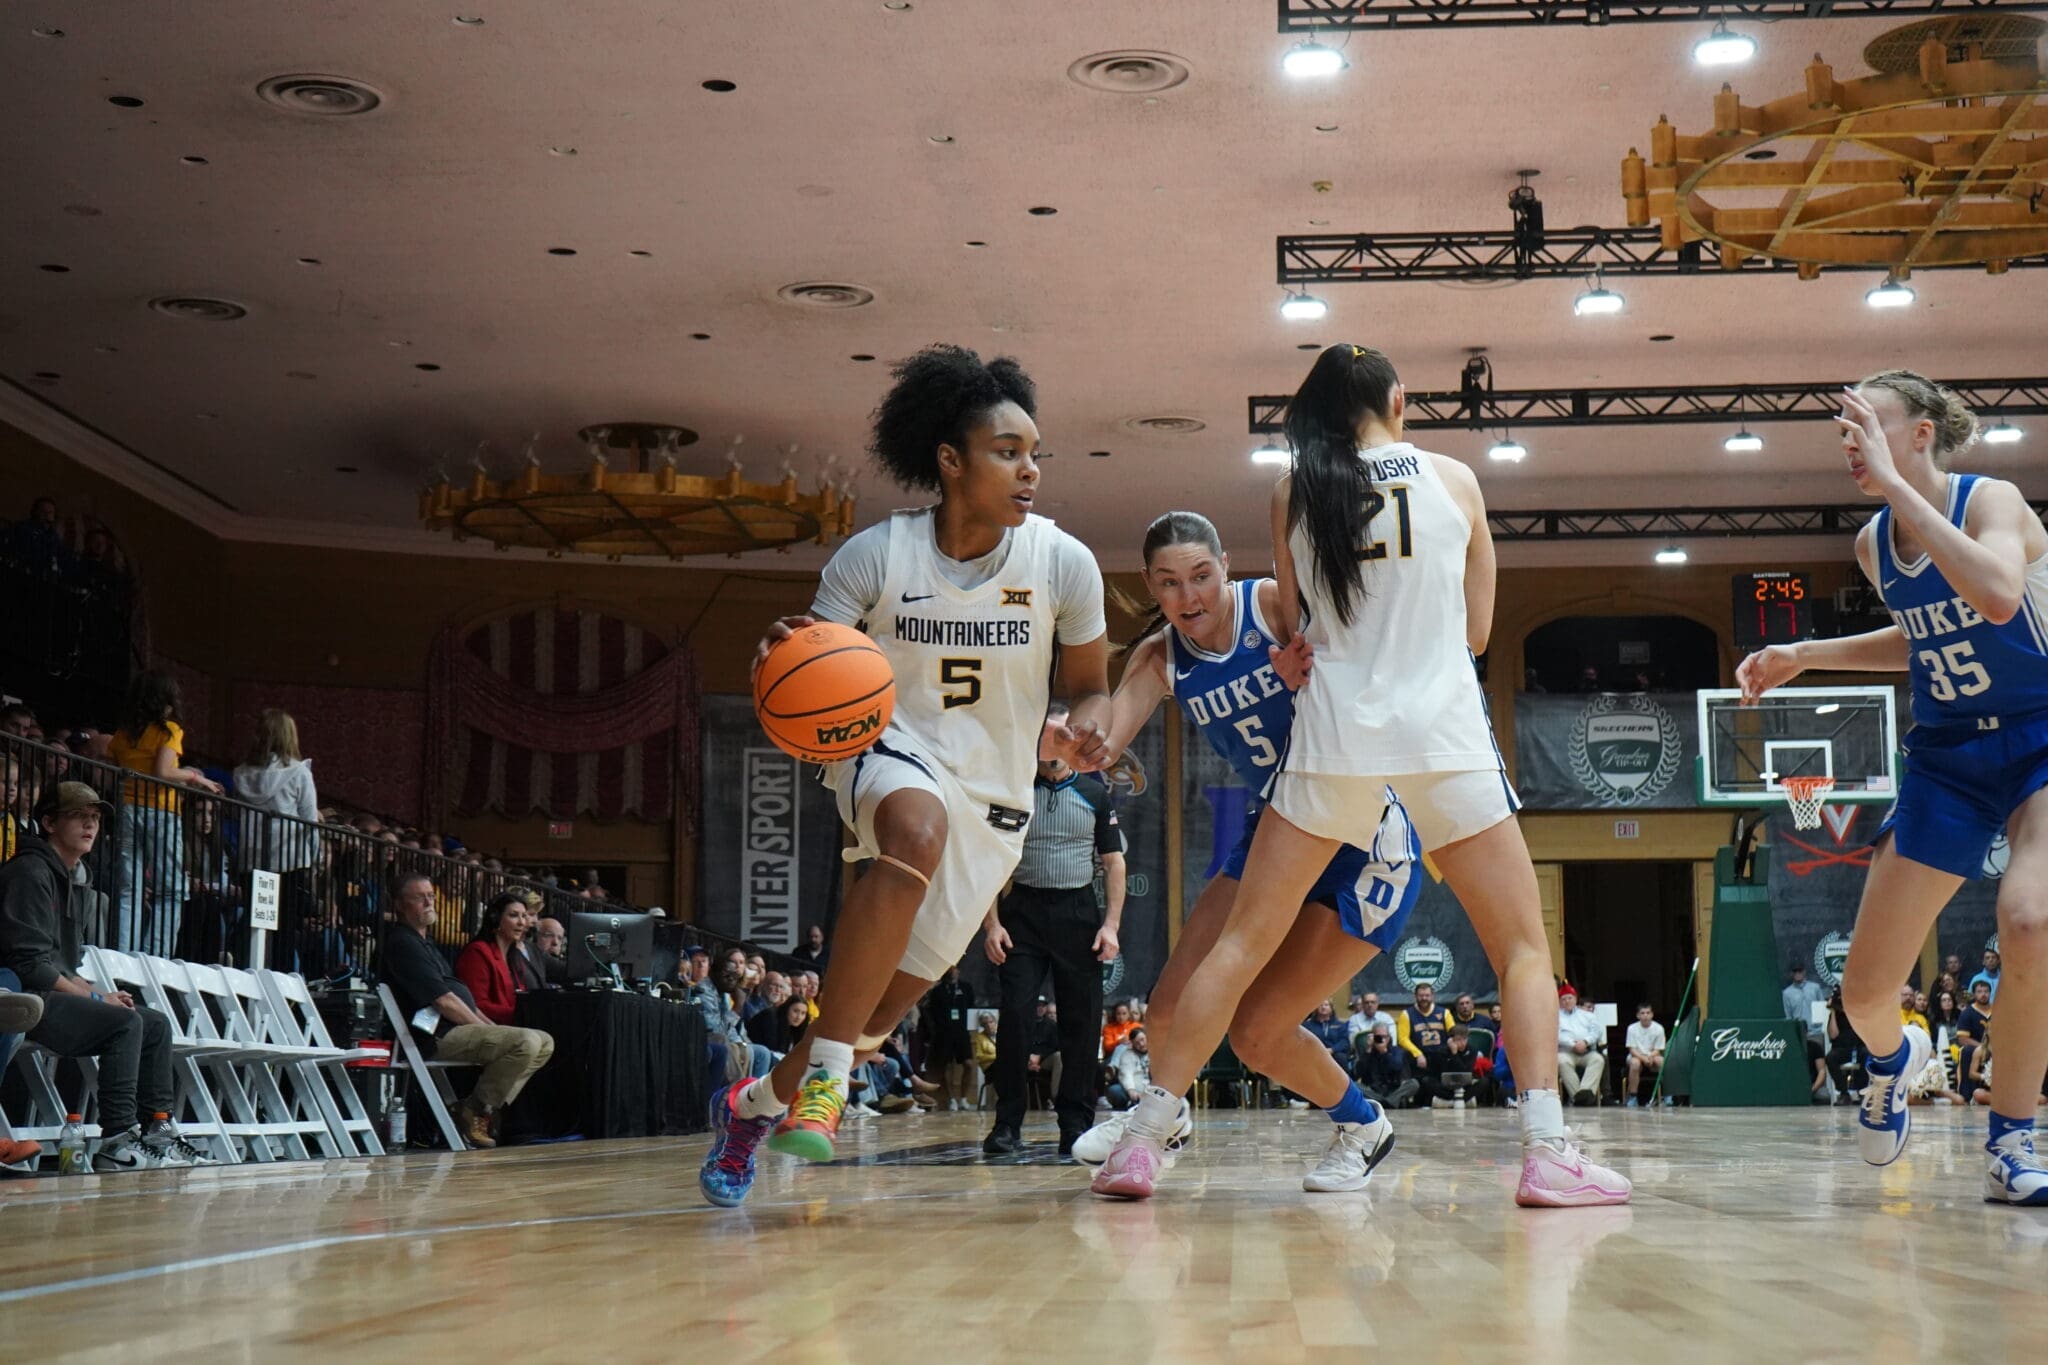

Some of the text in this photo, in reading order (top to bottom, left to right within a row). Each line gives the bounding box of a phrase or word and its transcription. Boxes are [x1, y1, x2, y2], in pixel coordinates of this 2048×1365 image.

[1755, 578, 1804, 601] 2:45
[895, 615, 1030, 647] MOUNTAINEERS
[1759, 602, 1796, 637] 17
[1892, 596, 1984, 640] DUKE
[940, 656, 983, 711] 5
[1919, 640, 1992, 700] 35
[1187, 663, 1283, 726] DUKE
[816, 709, 881, 745] NCAA
[1232, 714, 1278, 767] 5
[1618, 822, 1636, 837] EXIT
